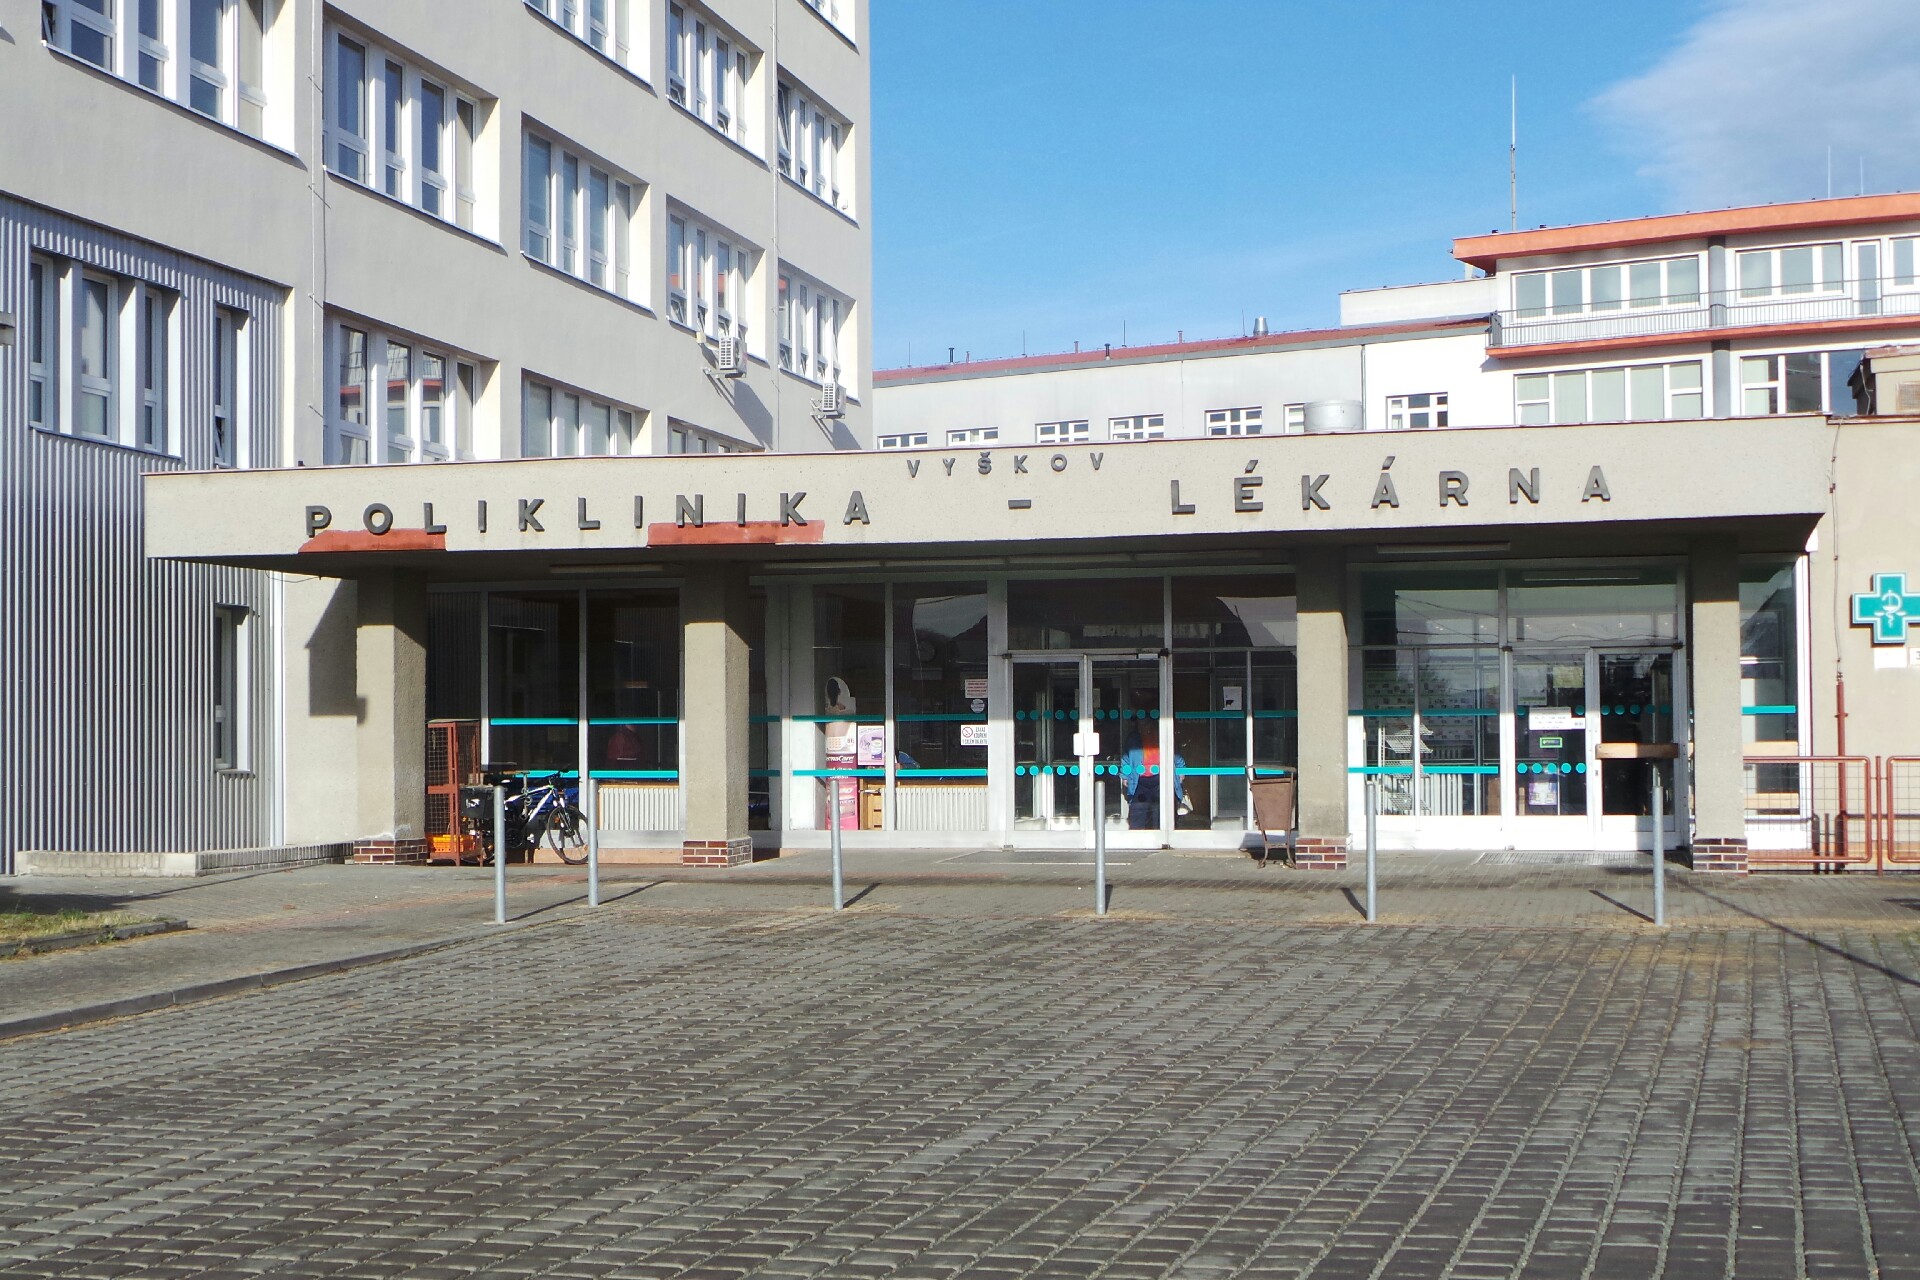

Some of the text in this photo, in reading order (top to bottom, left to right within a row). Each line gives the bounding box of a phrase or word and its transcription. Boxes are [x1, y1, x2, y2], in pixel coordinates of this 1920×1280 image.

[907, 451, 1104, 478] VYŠKOV
[305, 490, 871, 538] POLIKLINIKA
[1171, 456, 1611, 515] LÉKÁRNA
